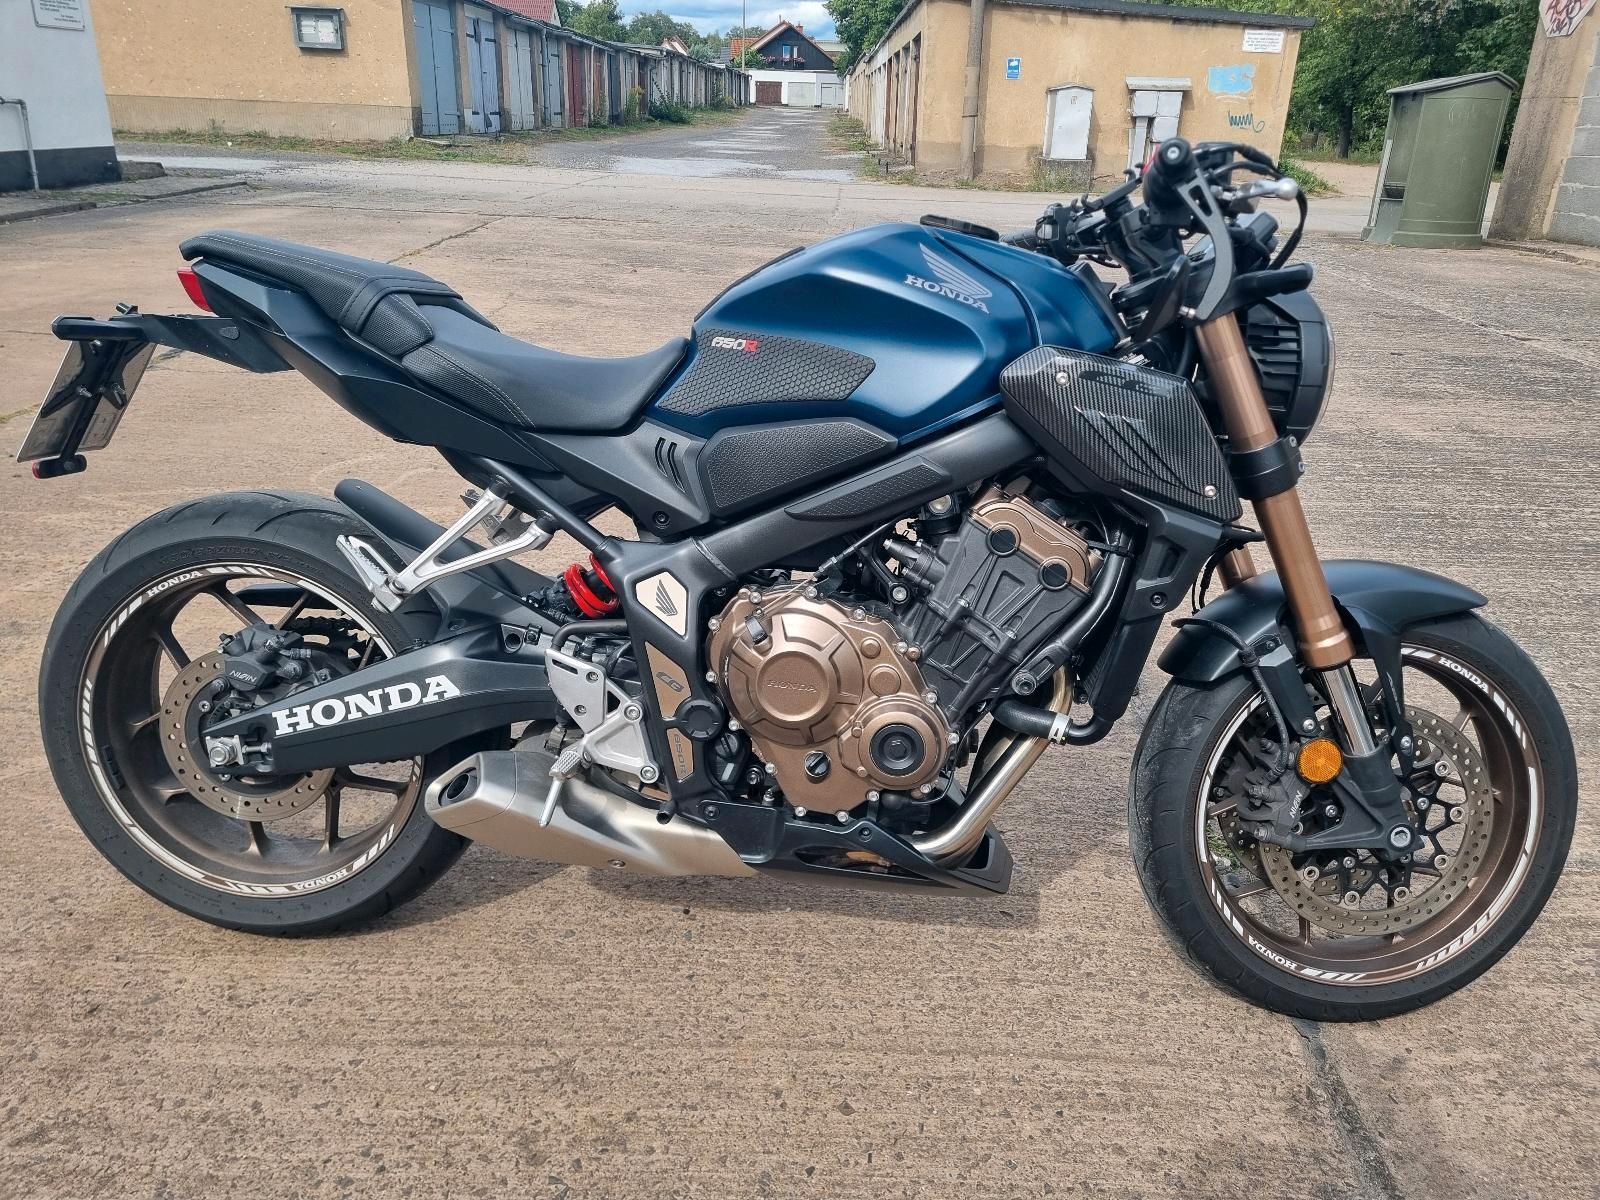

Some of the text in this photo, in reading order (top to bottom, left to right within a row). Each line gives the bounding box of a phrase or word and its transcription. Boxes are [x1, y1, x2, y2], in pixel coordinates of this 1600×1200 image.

[904, 274, 989, 314] HONDA
[711, 336, 758, 352] 650R
[147, 570, 203, 598] HONDA
[1438, 656, 1489, 694] HONDA
[272, 674, 461, 736] HONDA
[292, 868, 349, 890] HONDA
[1248, 935, 1297, 970] HONDA
